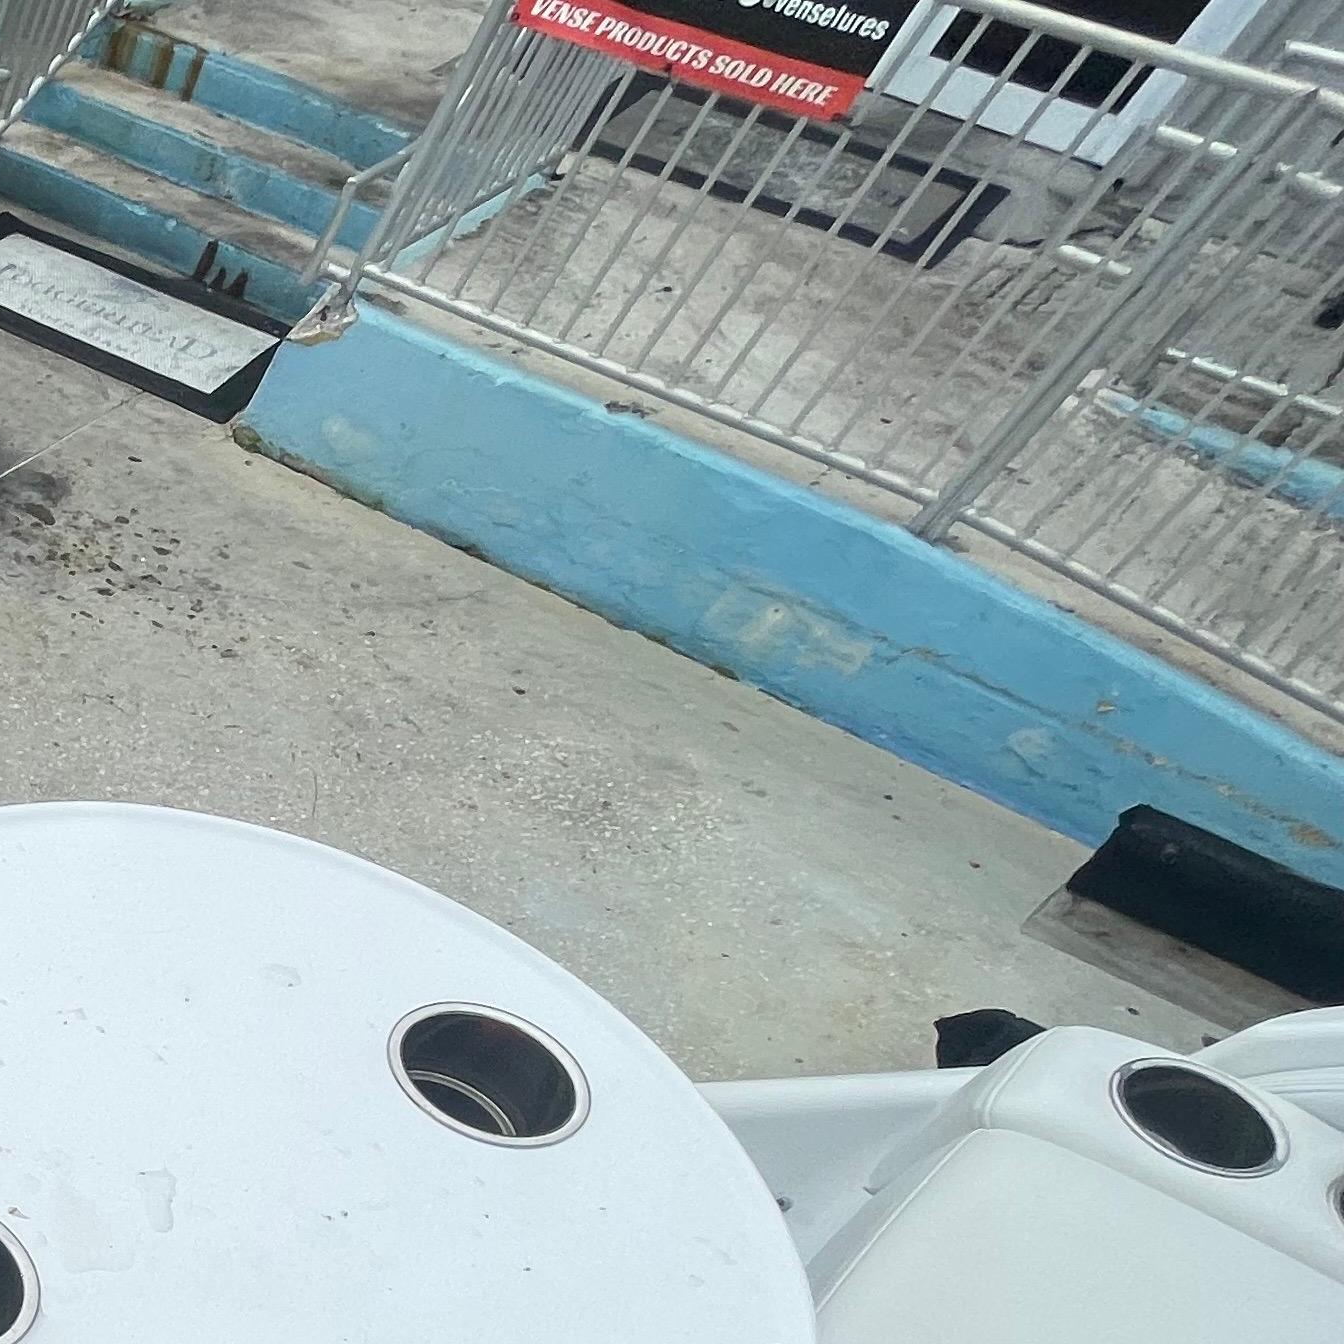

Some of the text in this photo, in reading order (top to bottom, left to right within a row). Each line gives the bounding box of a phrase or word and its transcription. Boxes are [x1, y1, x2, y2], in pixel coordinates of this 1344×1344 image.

[531, 0, 839, 106] VENSE PRODUCTS SOLD HERE
[762, 0, 889, 40] venselures
